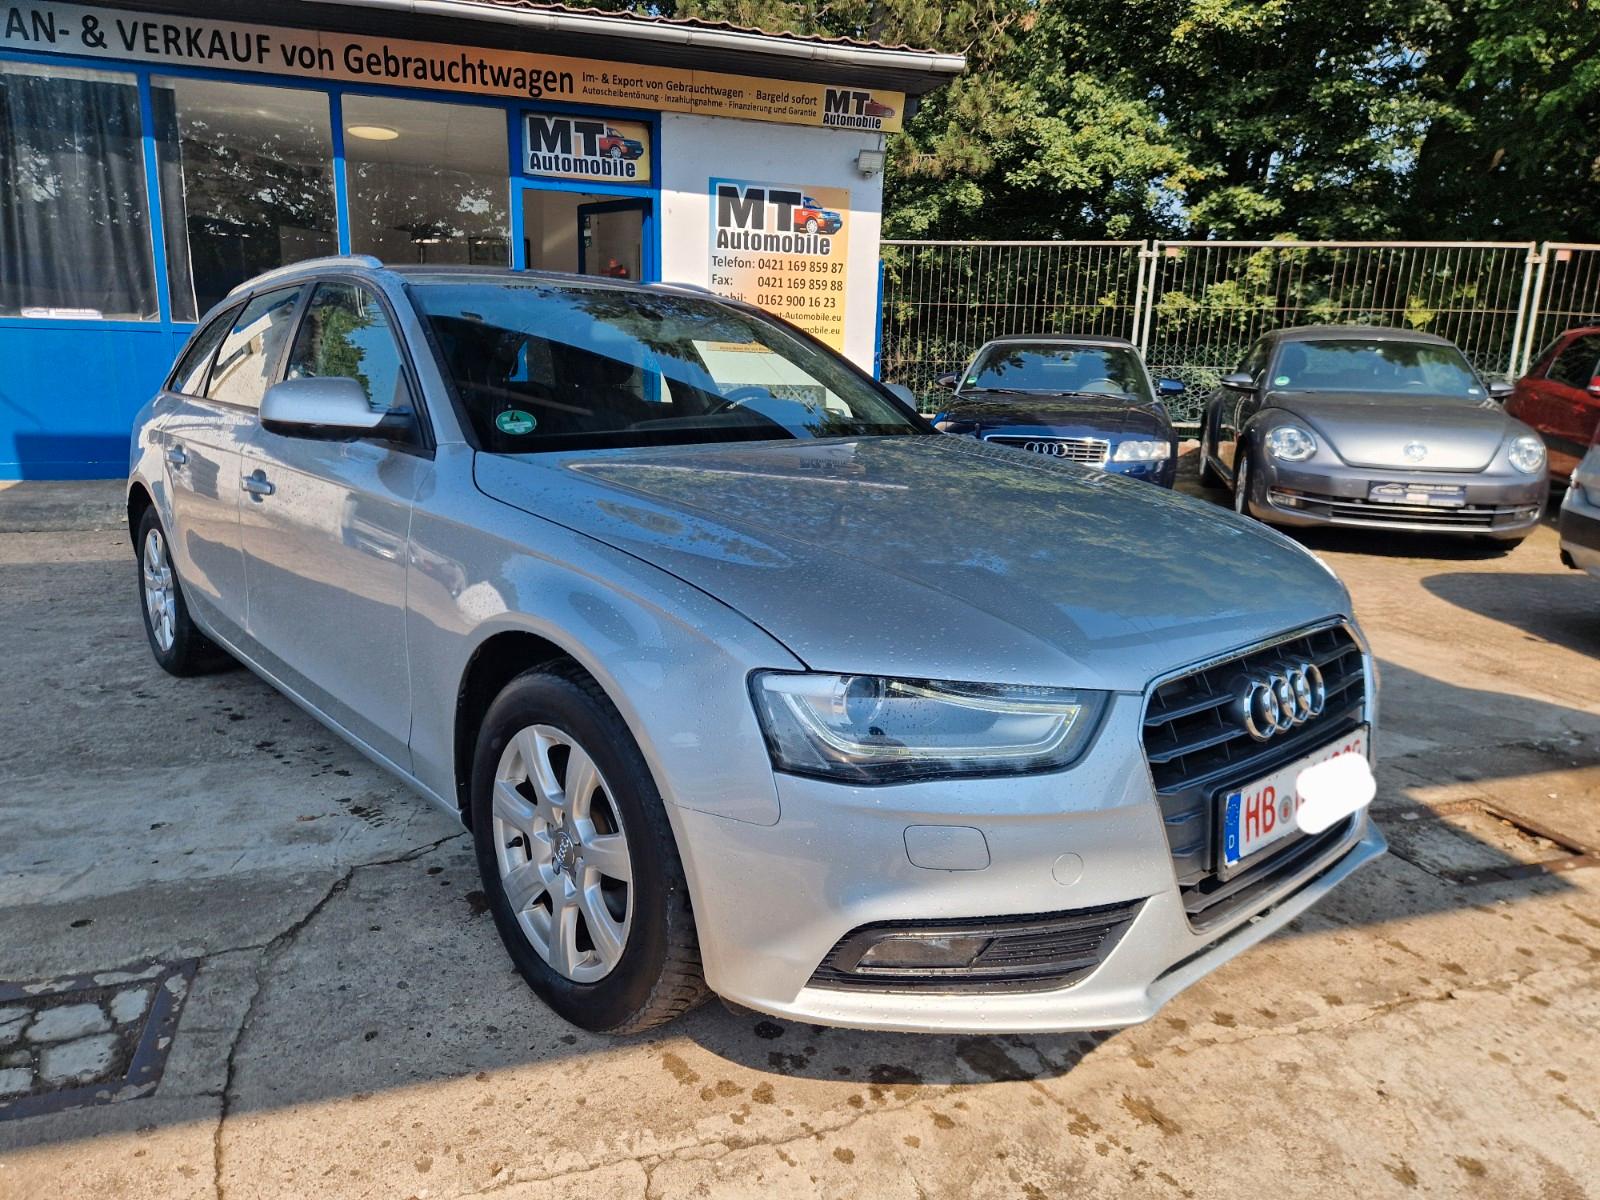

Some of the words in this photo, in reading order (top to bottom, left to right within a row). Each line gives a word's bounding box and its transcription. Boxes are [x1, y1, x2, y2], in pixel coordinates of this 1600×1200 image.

[5, 7, 69, 43] AN-
[81, 14, 107, 49] &
[117, 19, 270, 63] VERKAUF
[280, 44, 334, 72] von
[344, 44, 573, 97] Gebrauchtwagen
[582, 71, 599, 83] Im-
[601, 73, 609, 84] &
[613, 74, 643, 89] Export
[647, 80, 662, 91] von
[665, 80, 744, 99] Gebrauchtwagen
[756, 89, 789, 104] Bargeld
[791, 93, 817, 106] sofort
[825, 88, 870, 115] MT
[728, 100, 772, 114] Finanzierung
[773, 104, 787, 114] und
[788, 107, 817, 117] Garantie
[822, 112, 882, 129] Automobile
[528, 117, 605, 157] MT
[530, 152, 636, 178] Automobile
[717, 185, 802, 232] MT
[716, 228, 831, 256] Automobile
[711, 255, 756, 269] Telefon:
[758, 258, 784, 271] 0421
[788, 260, 806, 272] 169
[809, 261, 828, 273] 859
[831, 262, 844, 274] 87
[711, 273, 733, 286] Fax:
[757, 276, 783, 289] 0421
[787, 278, 806, 290] 169
[809, 279, 828, 291] 859
[830, 280, 843, 292] 88
[757, 293, 783, 306] 0162
[786, 295, 806, 307] 900
[808, 296, 821, 308] 16
[823, 297, 836, 308] 23
[1246, 785, 1276, 843] HB
